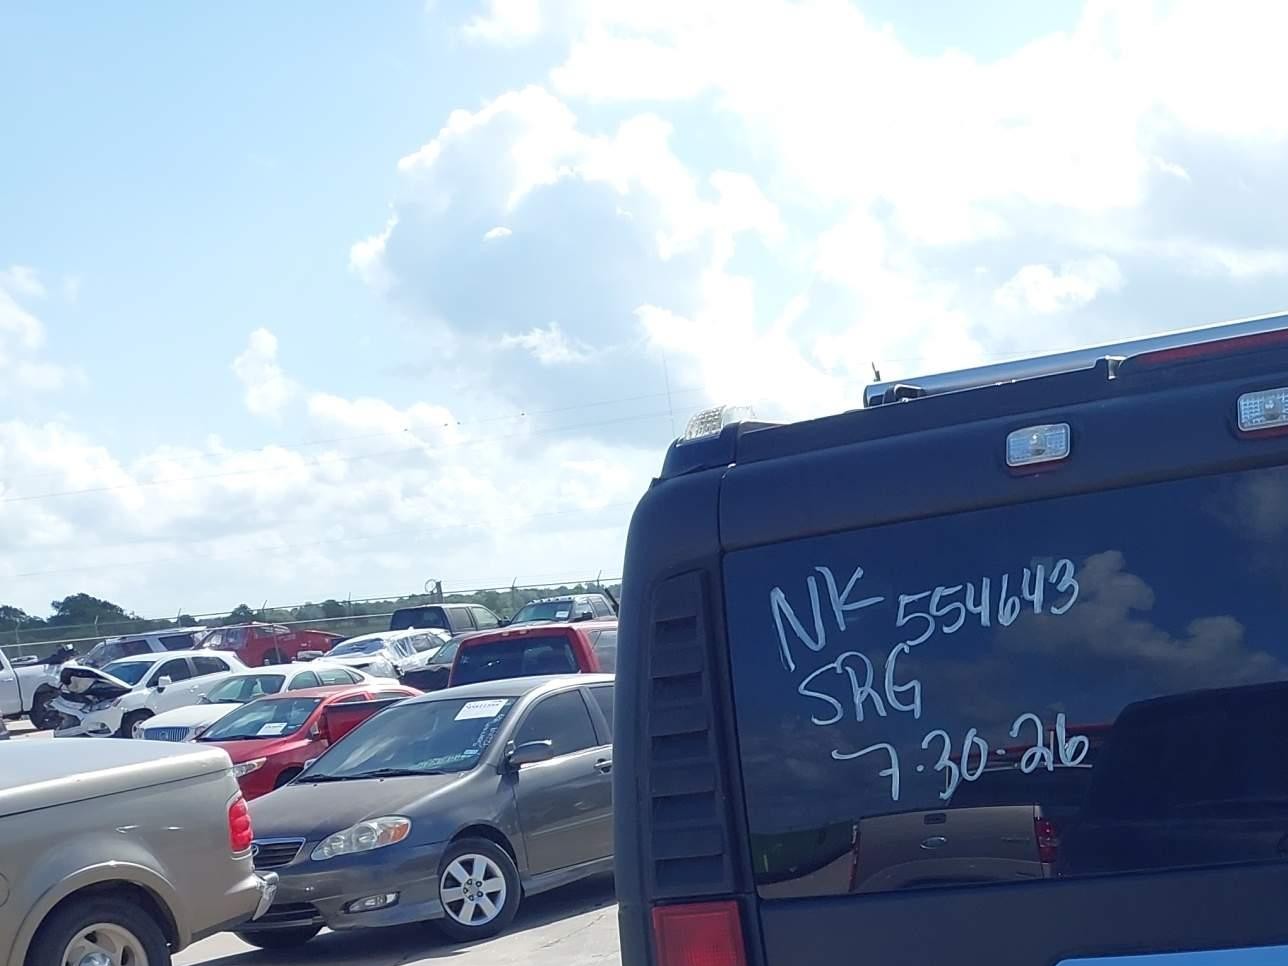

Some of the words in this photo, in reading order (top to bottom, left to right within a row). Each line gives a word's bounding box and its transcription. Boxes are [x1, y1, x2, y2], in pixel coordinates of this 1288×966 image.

[770, 565, 885, 673] NK
[895, 558, 1080, 647] 554643
[798, 642, 922, 726] SRG
